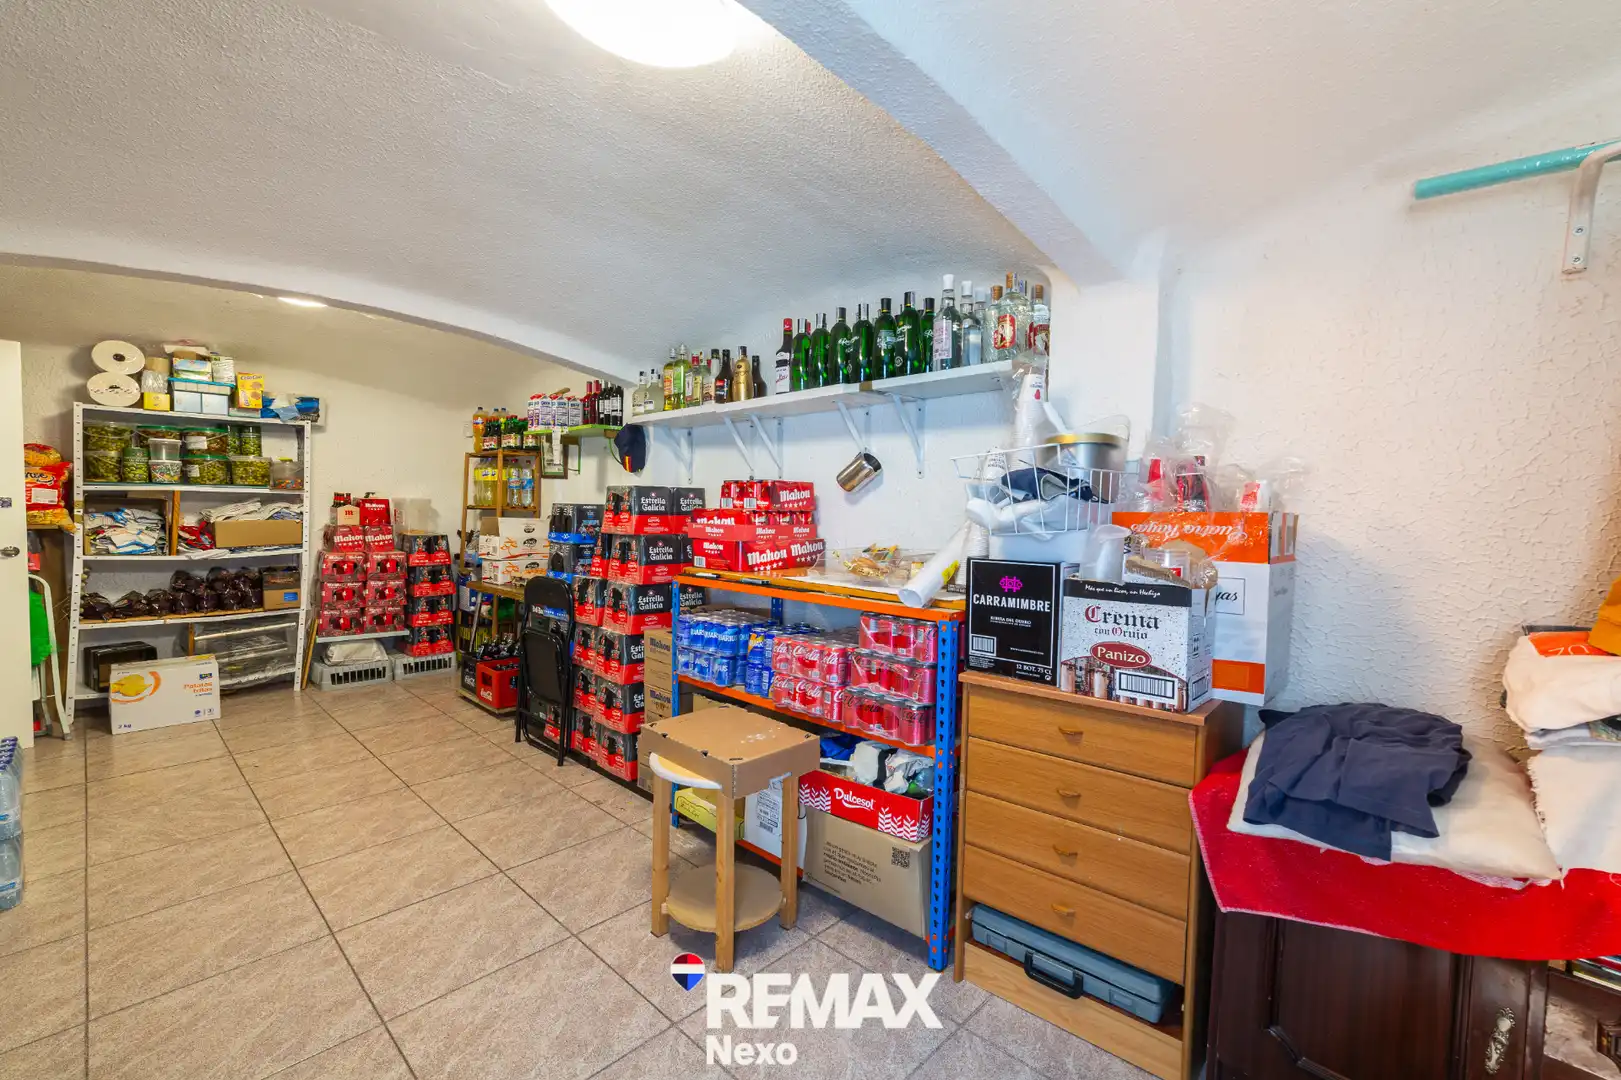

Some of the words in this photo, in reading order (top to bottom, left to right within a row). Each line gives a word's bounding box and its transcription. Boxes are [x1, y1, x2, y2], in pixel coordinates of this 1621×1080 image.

[640, 497, 667, 505] Estrella
[780, 489, 811, 502] Mahou
[641, 503, 666, 512] Galicia
[648, 546, 674, 554] Estrella
[702, 541, 724, 550] Mahou
[790, 540, 824, 556] Mahou
[650, 553, 673, 561] Galicia
[747, 548, 788, 566] Mahou
[638, 595, 664, 604] Estrella
[973, 593, 1051, 613] CARRAMIMBRE
[1215, 591, 1238, 603] yas
[639, 602, 664, 611] Galicia
[1084, 604, 1160, 630] Crema
[1094, 626, 1110, 636] con
[1111, 627, 1148, 641] Orujo
[1097, 645, 1146, 665] Panizo
[833, 787, 876, 810] Dulcesol
